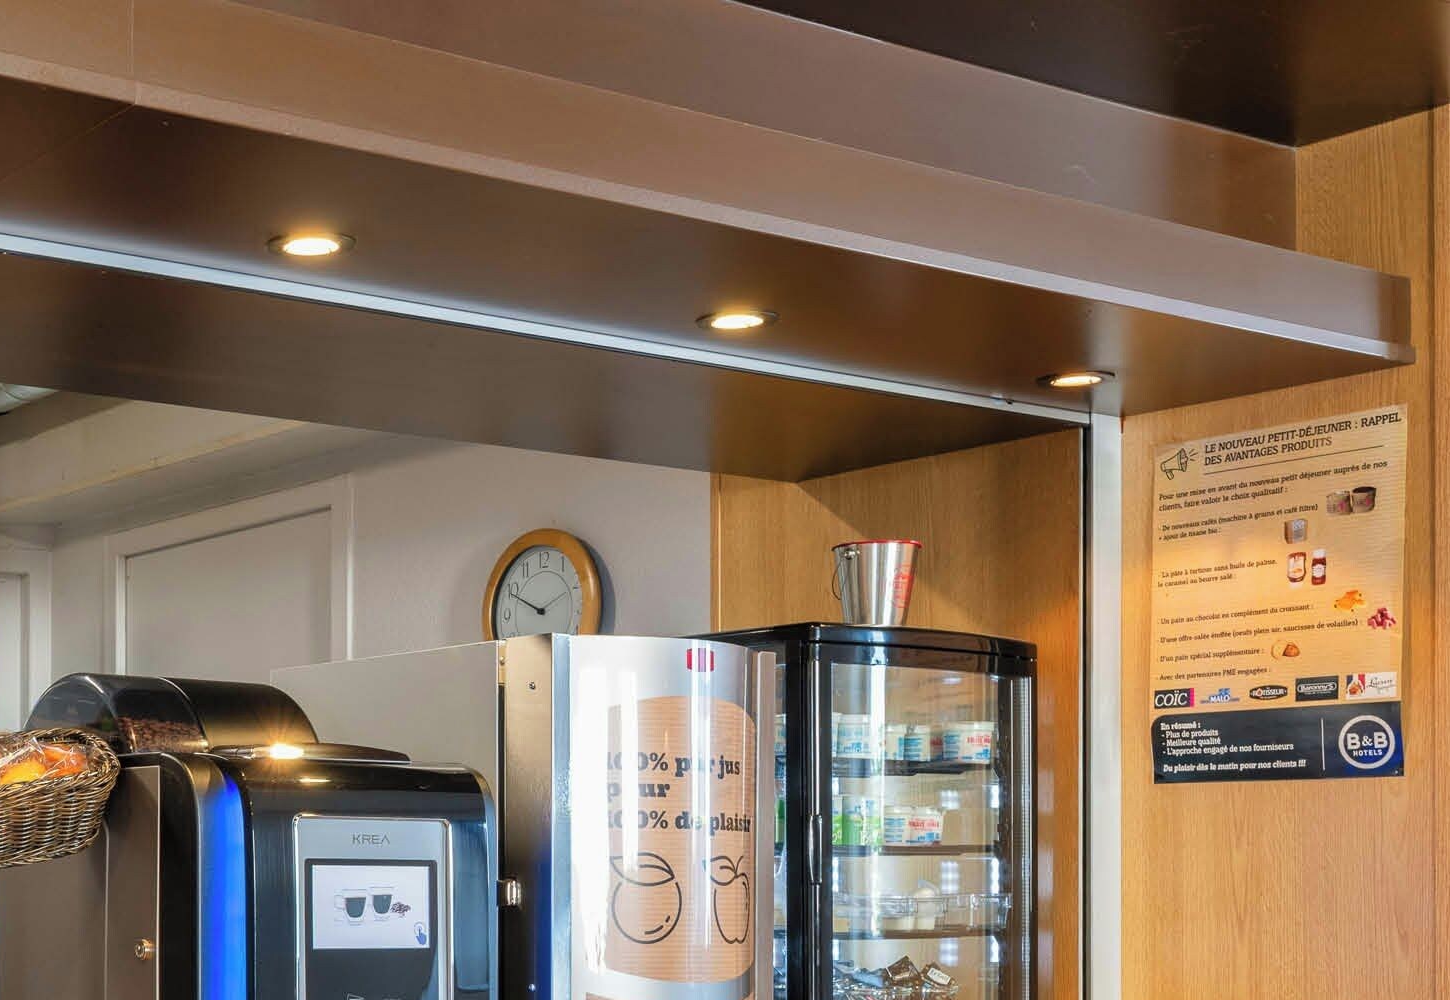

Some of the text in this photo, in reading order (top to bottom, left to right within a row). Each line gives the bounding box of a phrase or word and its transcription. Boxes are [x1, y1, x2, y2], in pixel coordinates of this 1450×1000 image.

[1205, 444, 1217, 454] LE
[1218, 435, 1266, 452] NOUVEAU
[1268, 420, 1352, 443] PETIT-DÉJEUNER
[1361, 412, 1402, 428] RAPPEL
[1204, 437, 1332, 466] DES AVANTAGES PRODUITS
[1159, 493, 1174, 501] Pour
[1190, 488, 1207, 497] mise
[1218, 483, 1237, 492] avant
[1238, 481, 1248, 489] du
[1249, 477, 1279, 487] nouveau
[1281, 471, 1298, 484] petit
[1299, 469, 1332, 482] déjeuner
[1334, 464, 1360, 476] auprès
[1361, 462, 1371, 470] de
[1373, 461, 1388, 470] nos
[1184, 500, 1199, 508] faire
[1201, 497, 1221, 505] valoir
[1231, 493, 1250, 501] choix
[1251, 486, 1283, 499] qualitatif
[1254, 511, 1275, 520] grains
[1284, 506, 1298, 514] café
[539, 551, 550, 569] 12
[1247, 560, 1255, 568] de
[522, 561, 530, 579] 11
[1165, 578, 1188, 587] caramel
[1198, 575, 1219, 584] beurre
[1220, 573, 1233, 581] salé
[507, 582, 519, 599] 10
[503, 608, 511, 623] 9
[1160, 617, 1170, 625] Un
[1171, 617, 1185, 625] pain
[1230, 608, 1269, 618] complément
[1283, 623, 1315, 632] saucisses
[1316, 621, 1325, 630] de
[1174, 654, 1189, 663] pain
[1160, 721, 1197, 731] En résumé
[1165, 729, 1219, 739] Plus de produits
[1346, 731, 1388, 750] B&B
[1166, 737, 1221, 747] Meilleure qualité
[1167, 747, 1202, 757] L'approche
[1229, 744, 1238, 753] de
[1239, 744, 1252, 752] nos
[1352, 749, 1384, 757] HOTELS
[717, 755, 741, 779] jus
[1163, 764, 1173, 772] Du
[1173, 763, 1196, 774] plaisir
[1209, 762, 1217, 770] le
[1217, 762, 1238, 770] matin
[1239, 762, 1256, 772] pour
[1258, 761, 1271, 769] nos
[1272, 760, 1297, 768] clients
[607, 782, 670, 802] pur
